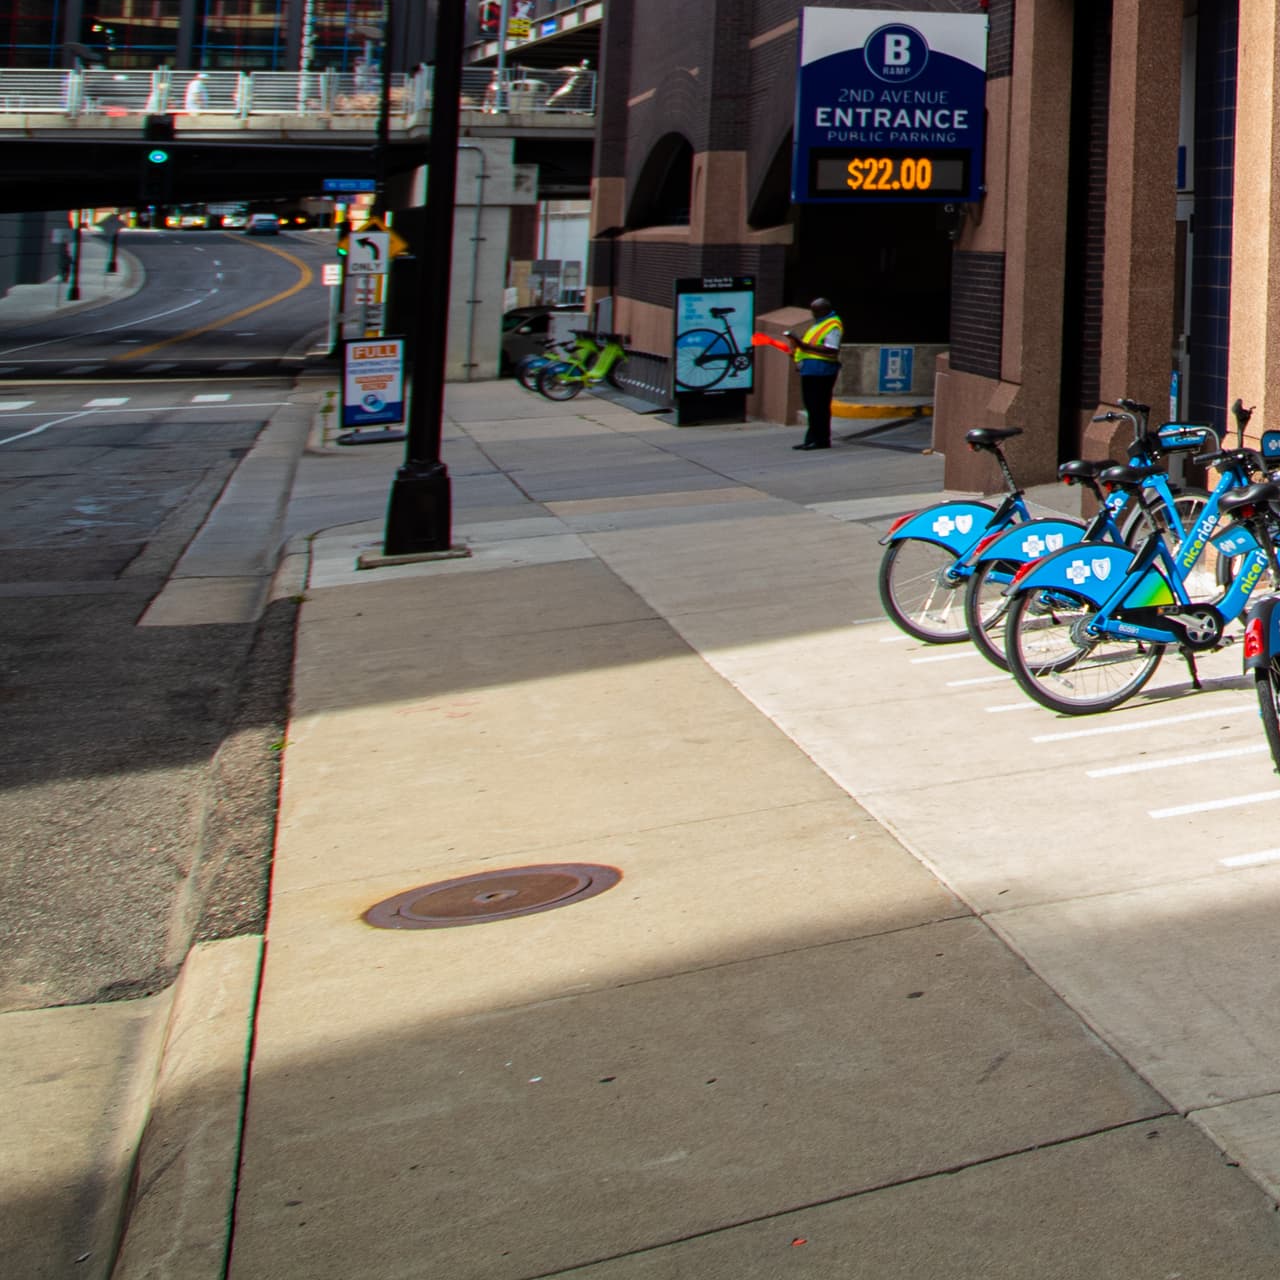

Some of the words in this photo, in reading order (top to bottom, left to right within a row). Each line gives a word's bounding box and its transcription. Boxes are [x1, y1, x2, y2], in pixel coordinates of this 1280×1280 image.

[884, 33, 911, 66] B
[882, 66, 911, 75] RAMP
[838, 88, 875, 103] 2ND
[880, 90, 949, 105] AVENUE
[815, 107, 969, 129] ENTRANCE
[827, 130, 884, 143] PUBLIC
[889, 132, 957, 144] PARKING
[847, 157, 932, 190] $22.00
[352, 262, 381, 271] ONLY
[354, 345, 397, 358] FULL
[1183, 514, 1218, 568] niceride
[1240, 549, 1268, 595] niceri
